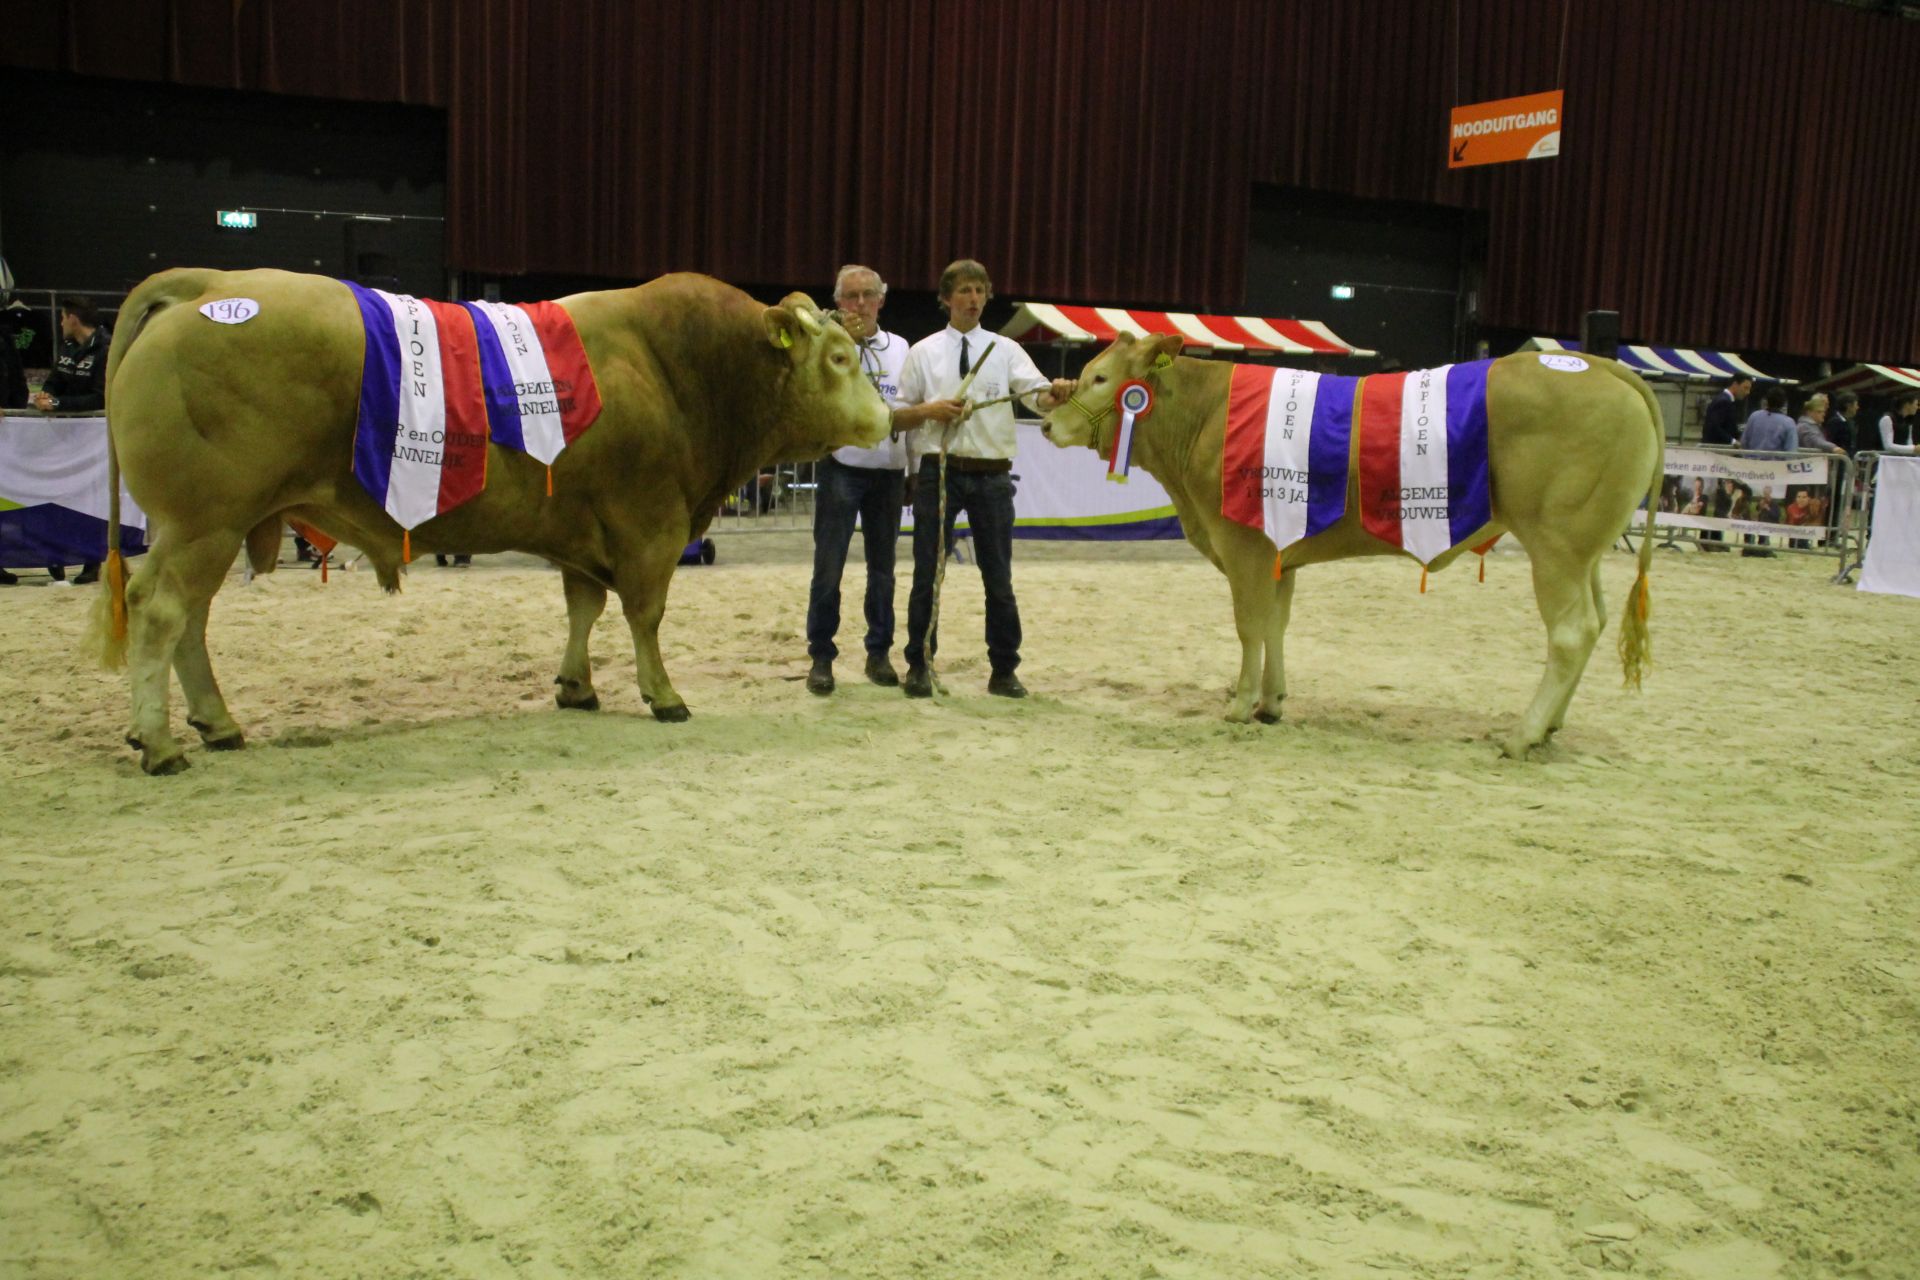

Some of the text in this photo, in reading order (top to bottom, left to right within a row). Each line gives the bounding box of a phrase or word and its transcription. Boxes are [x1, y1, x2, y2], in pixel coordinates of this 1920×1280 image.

[1453, 108, 1558, 138] NOODUITGANG
[209, 302, 250, 319] 196
[409, 430, 428, 442] en
[1692, 464, 1707, 472] aan
[1276, 487, 1286, 499] 3
